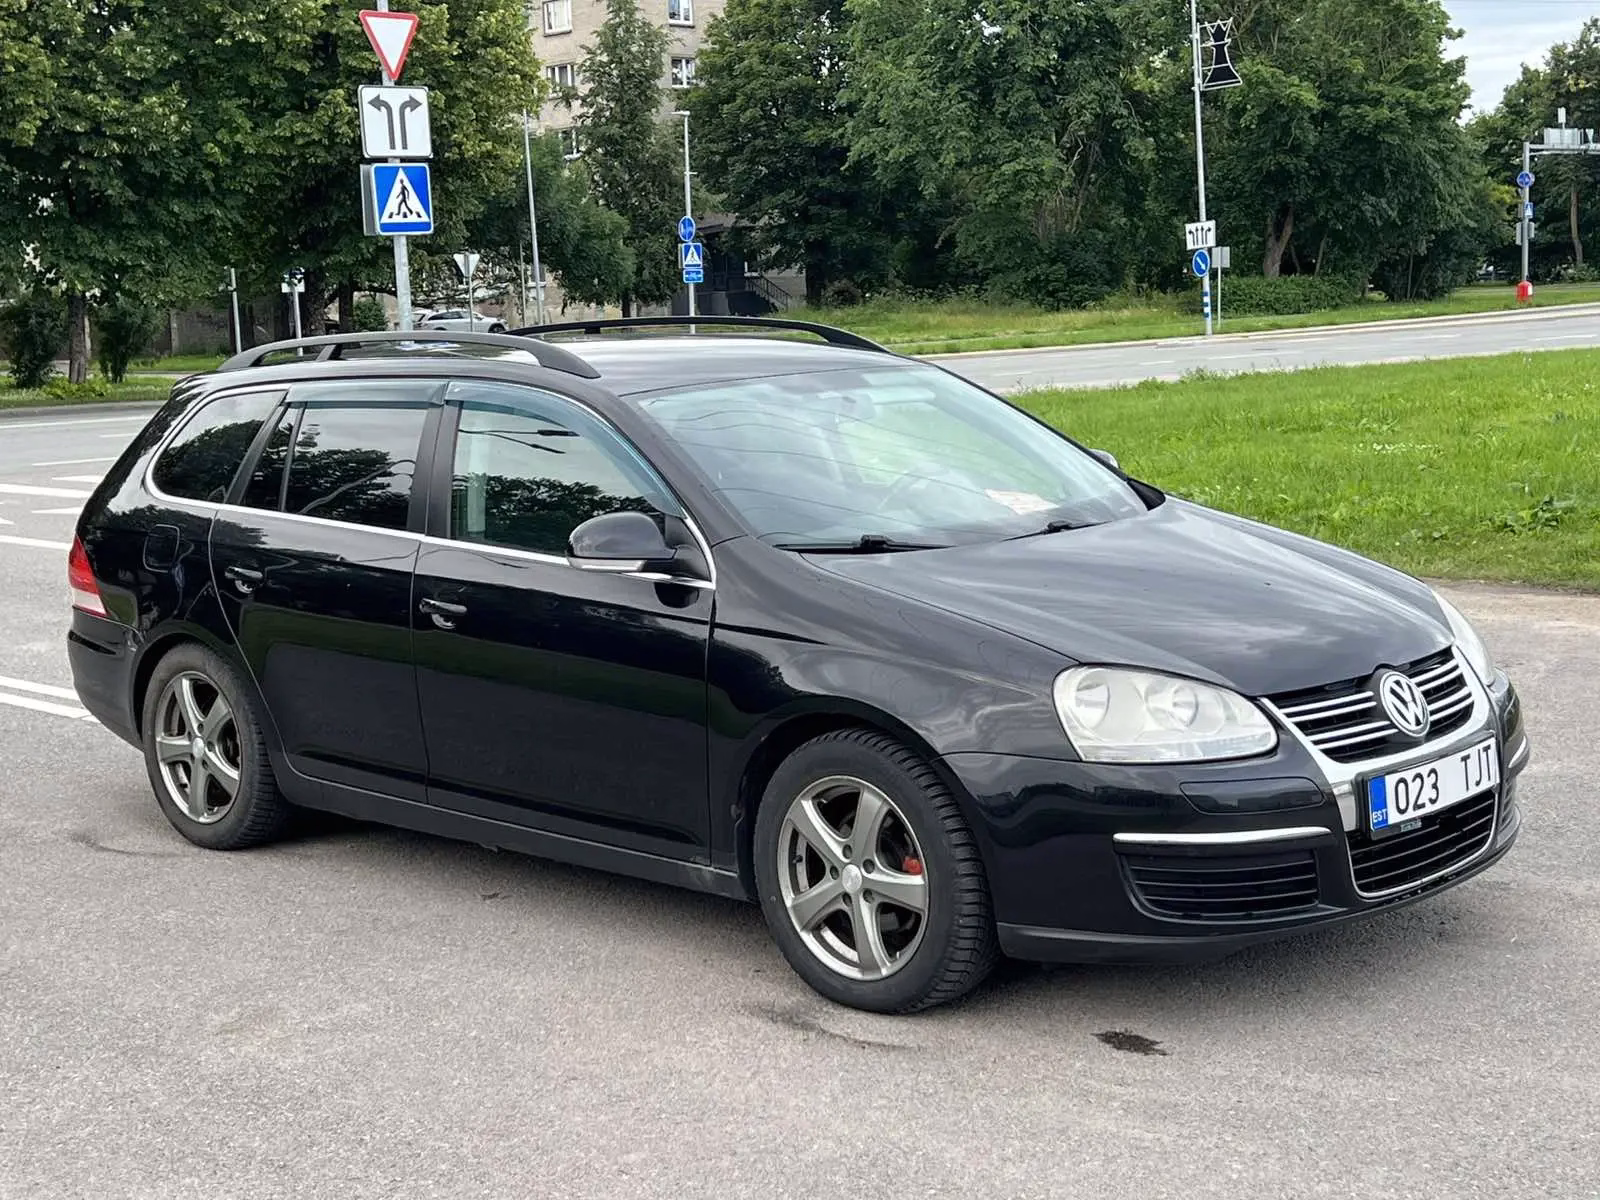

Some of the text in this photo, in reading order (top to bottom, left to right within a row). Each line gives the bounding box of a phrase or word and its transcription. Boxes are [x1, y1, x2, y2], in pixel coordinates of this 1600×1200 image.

[1383, 674, 1427, 731] VW
[1394, 744, 1491, 815] 023 TJT
[1372, 808, 1388, 822] EST
